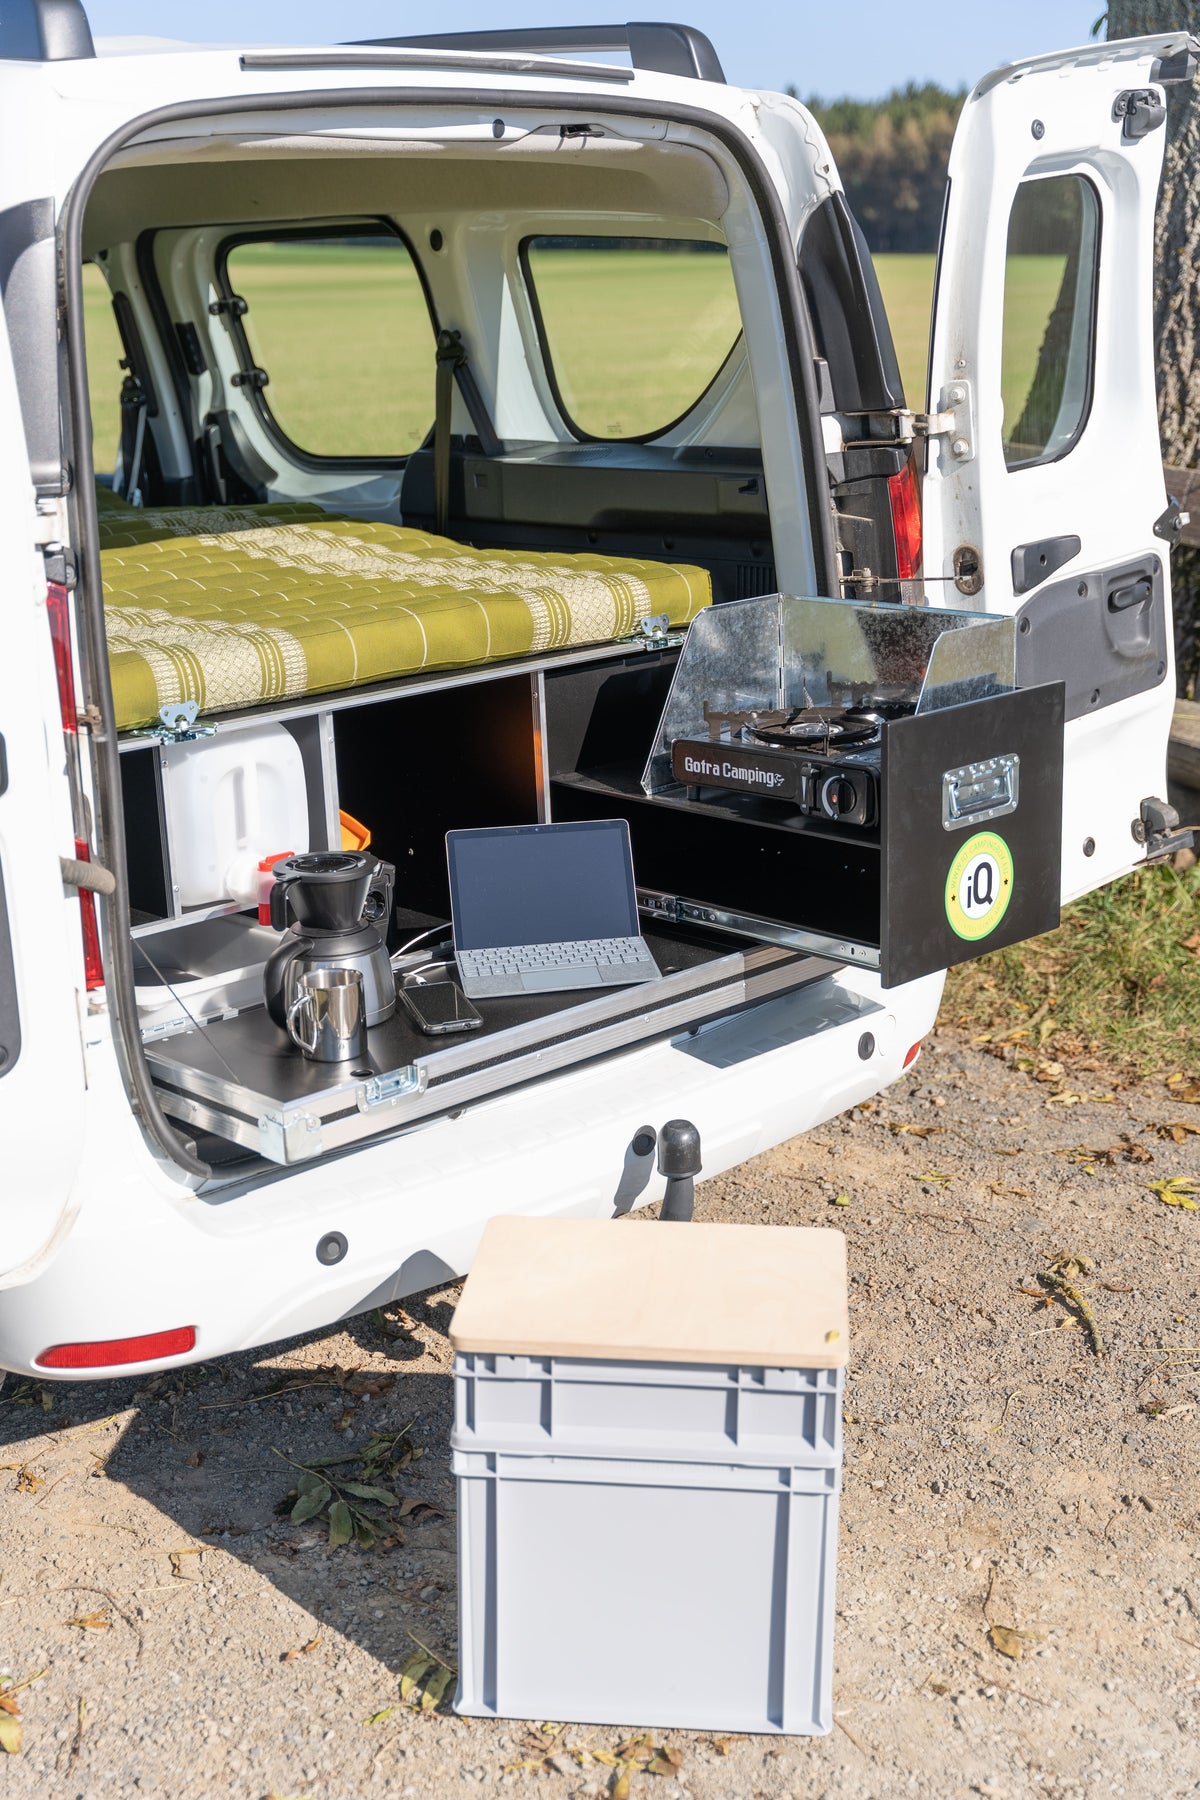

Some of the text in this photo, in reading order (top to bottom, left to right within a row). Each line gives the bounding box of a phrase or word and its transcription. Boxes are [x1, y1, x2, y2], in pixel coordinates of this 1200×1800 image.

[684, 756, 774, 788] Gotra Camping
[966, 861, 994, 909] iQ
